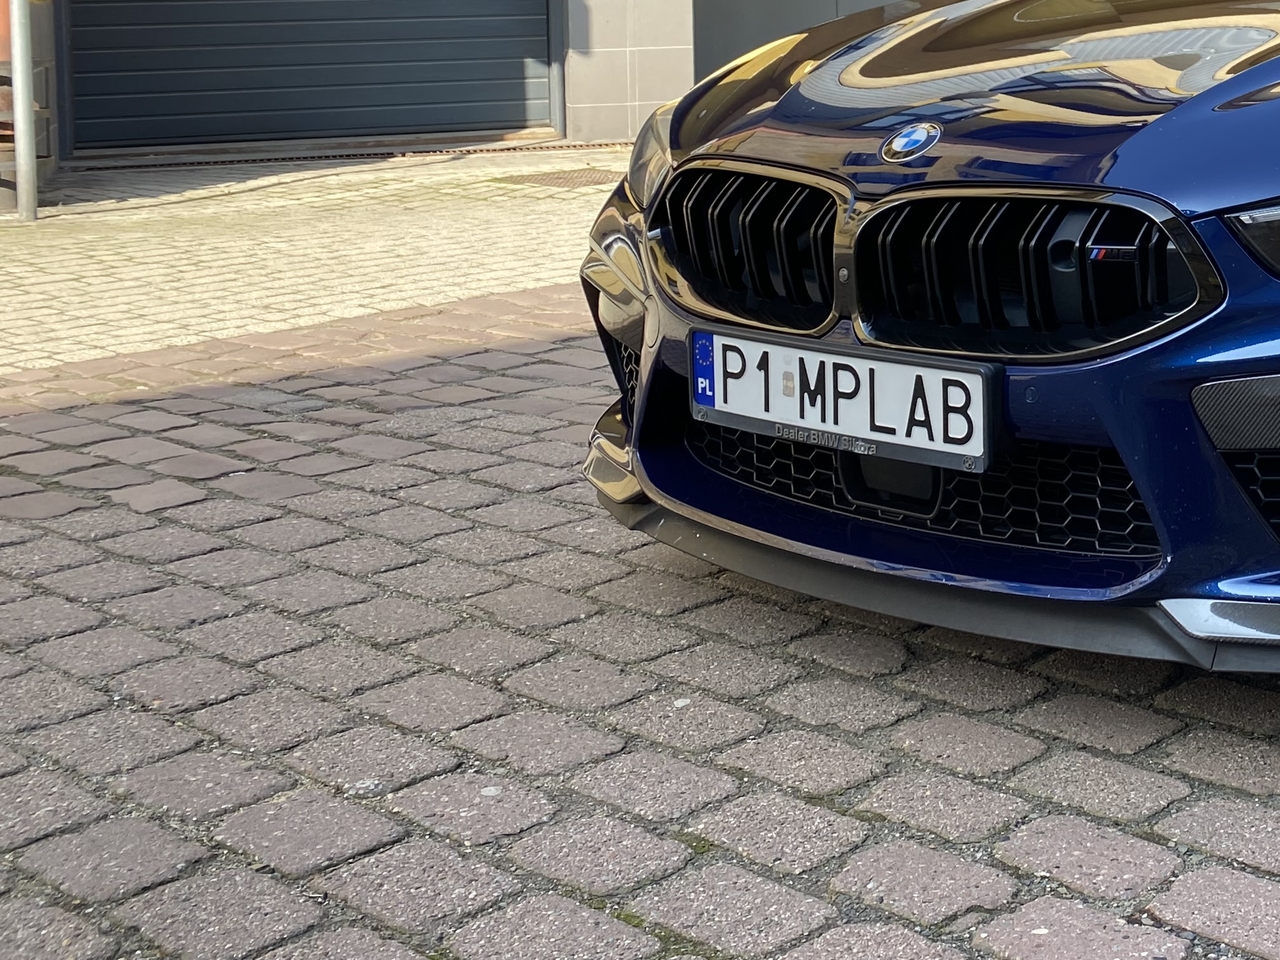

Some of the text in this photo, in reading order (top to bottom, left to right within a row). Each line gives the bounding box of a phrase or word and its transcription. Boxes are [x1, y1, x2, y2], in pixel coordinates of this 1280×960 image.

[697, 377, 713, 396] PL
[721, 343, 975, 446] P1 MPLAB
[775, 423, 809, 442] Dealer
[810, 430, 840, 448] BMW
